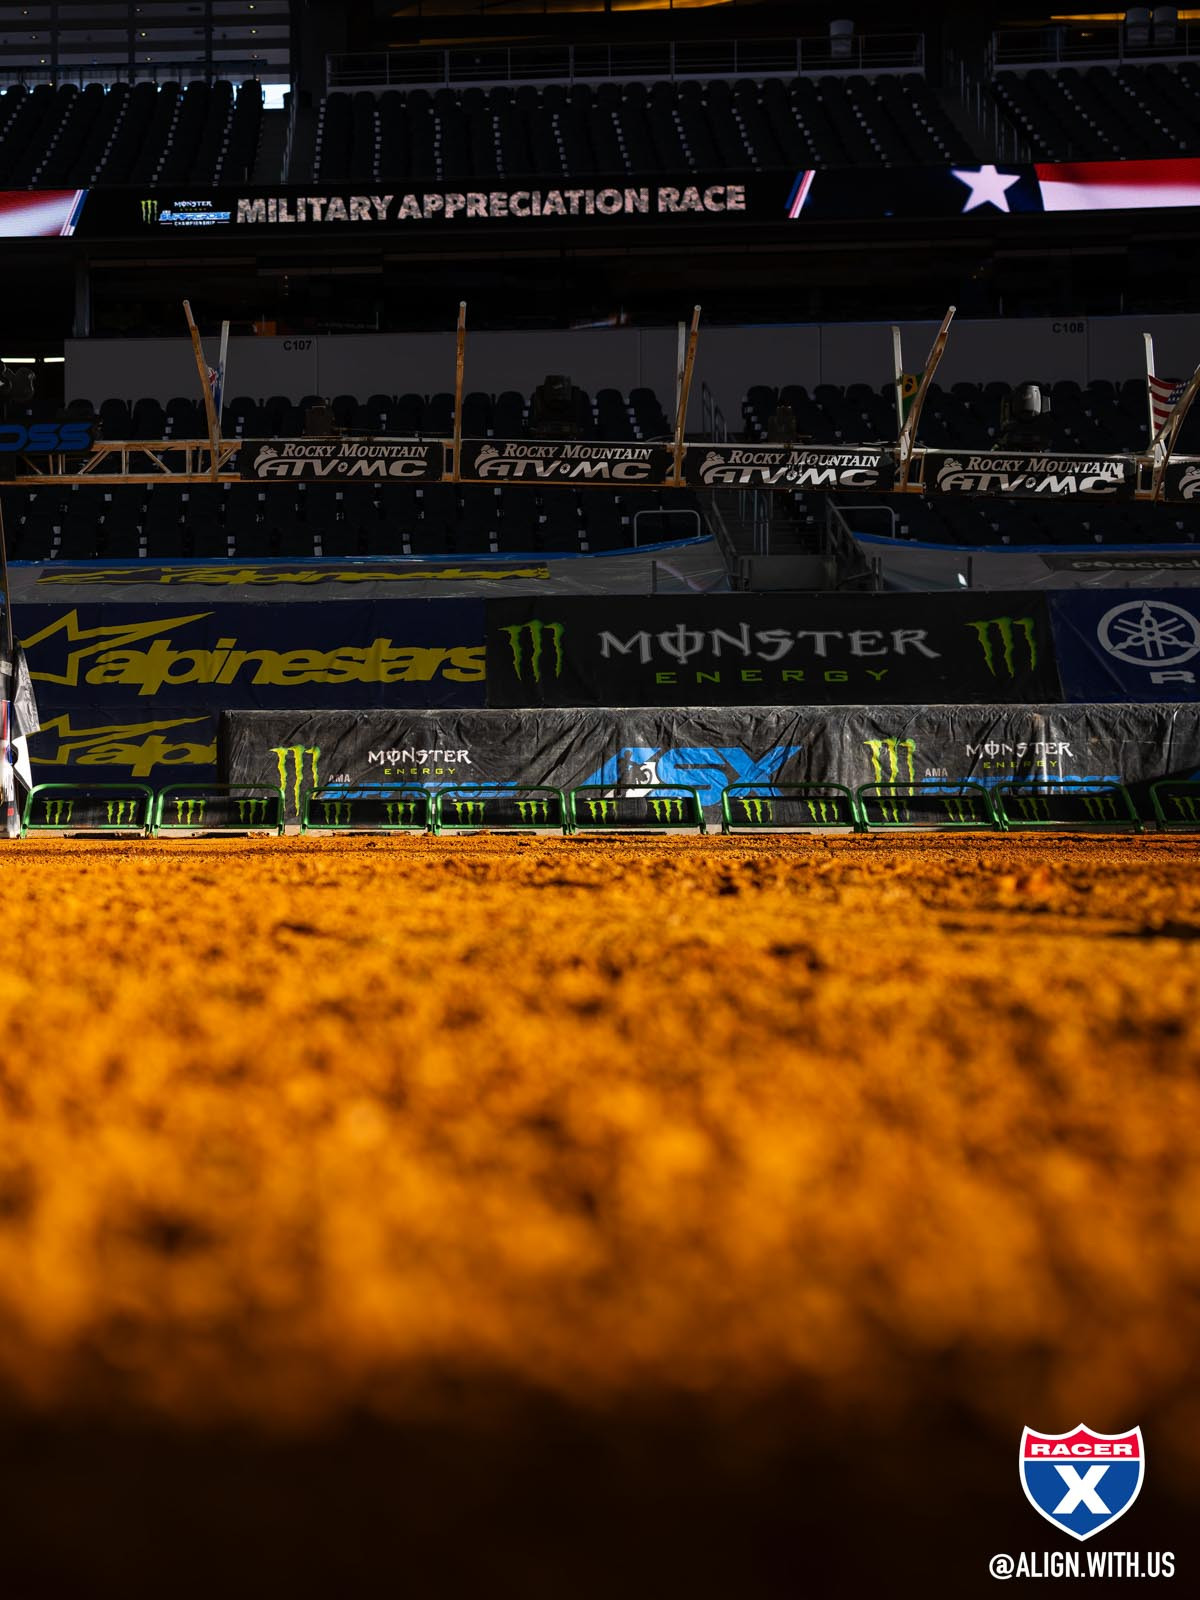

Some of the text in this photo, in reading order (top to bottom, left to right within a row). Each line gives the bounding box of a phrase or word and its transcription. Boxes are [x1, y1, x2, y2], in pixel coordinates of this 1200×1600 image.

[236, 184, 747, 224] MILITARY APPRECIATION RACE
[1051, 321, 1085, 335] C108
[282, 339, 313, 352] C107
[281, 443, 429, 458] ROCKY MOUNTAIN
[502, 443, 652, 461] ROCKY MOUNTAIN
[728, 449, 881, 468] ROCKY MOUNTAIN
[968, 456, 1124, 474] ROCKY MOUNTAIN
[599, 621, 941, 665] MONSTER
[85, 637, 487, 697] alpinestars
[655, 668, 889, 686] ENERGY
[366, 747, 472, 766] MONSTER
[965, 740, 1074, 759] MONSTER
[328, 774, 351, 783] AMA
[383, 767, 456, 776] ENERGY
[924, 768, 949, 777] AMA
